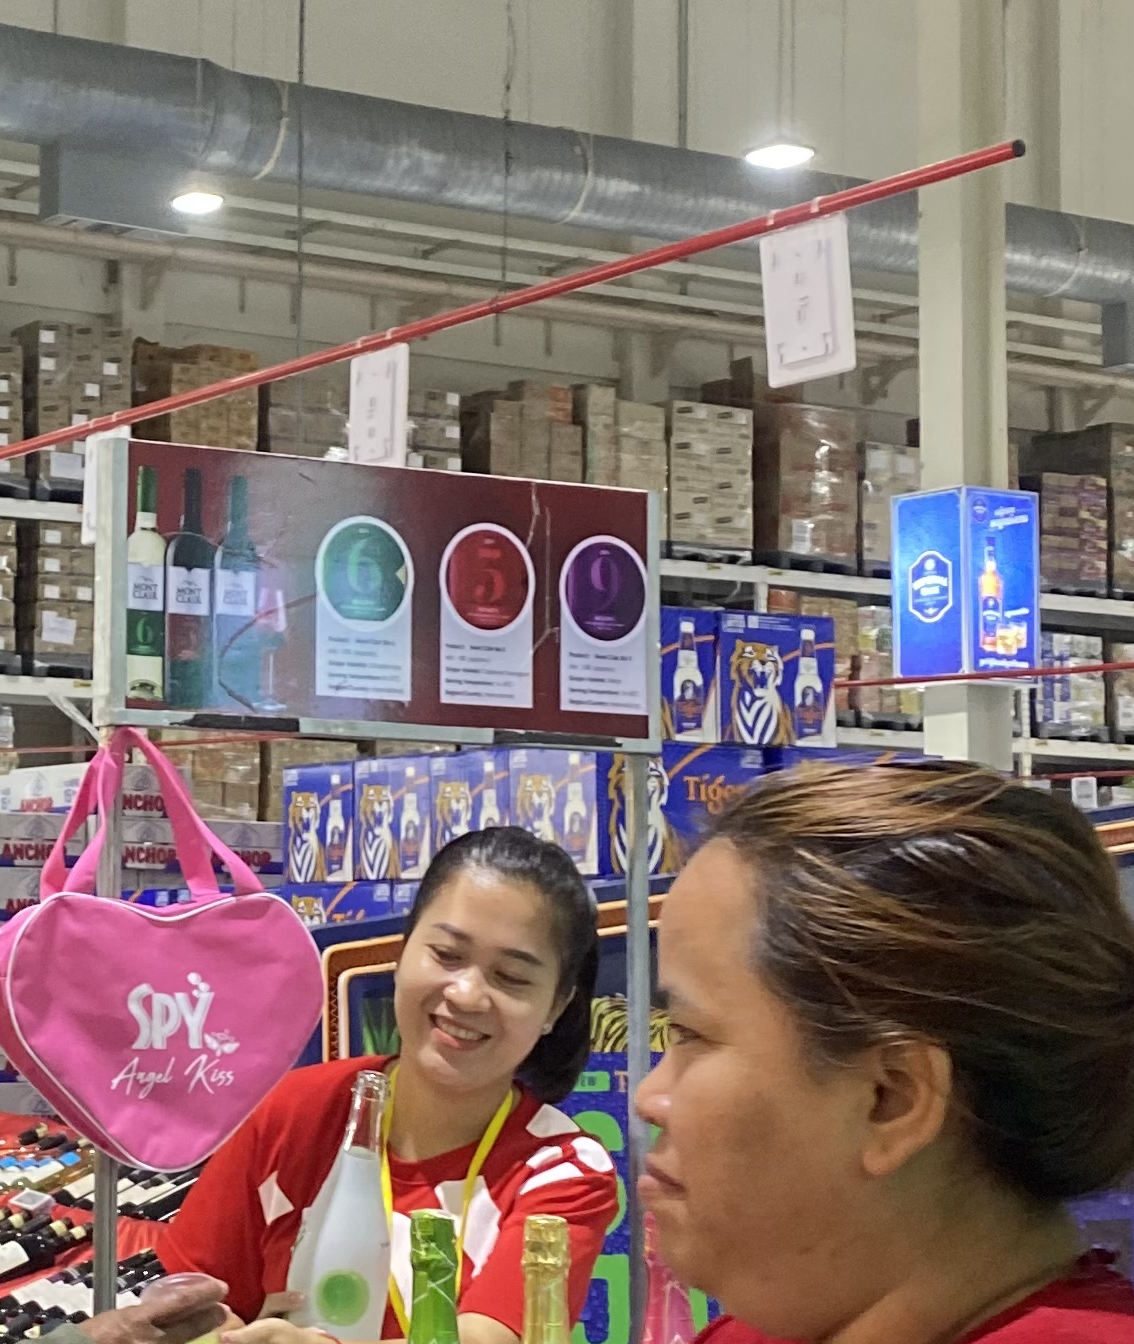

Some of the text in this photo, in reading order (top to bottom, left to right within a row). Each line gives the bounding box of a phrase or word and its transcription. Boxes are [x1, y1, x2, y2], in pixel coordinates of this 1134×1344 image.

[127, 983, 215, 1050] SPY
[110, 1054, 234, 1099] Angel Kiss
